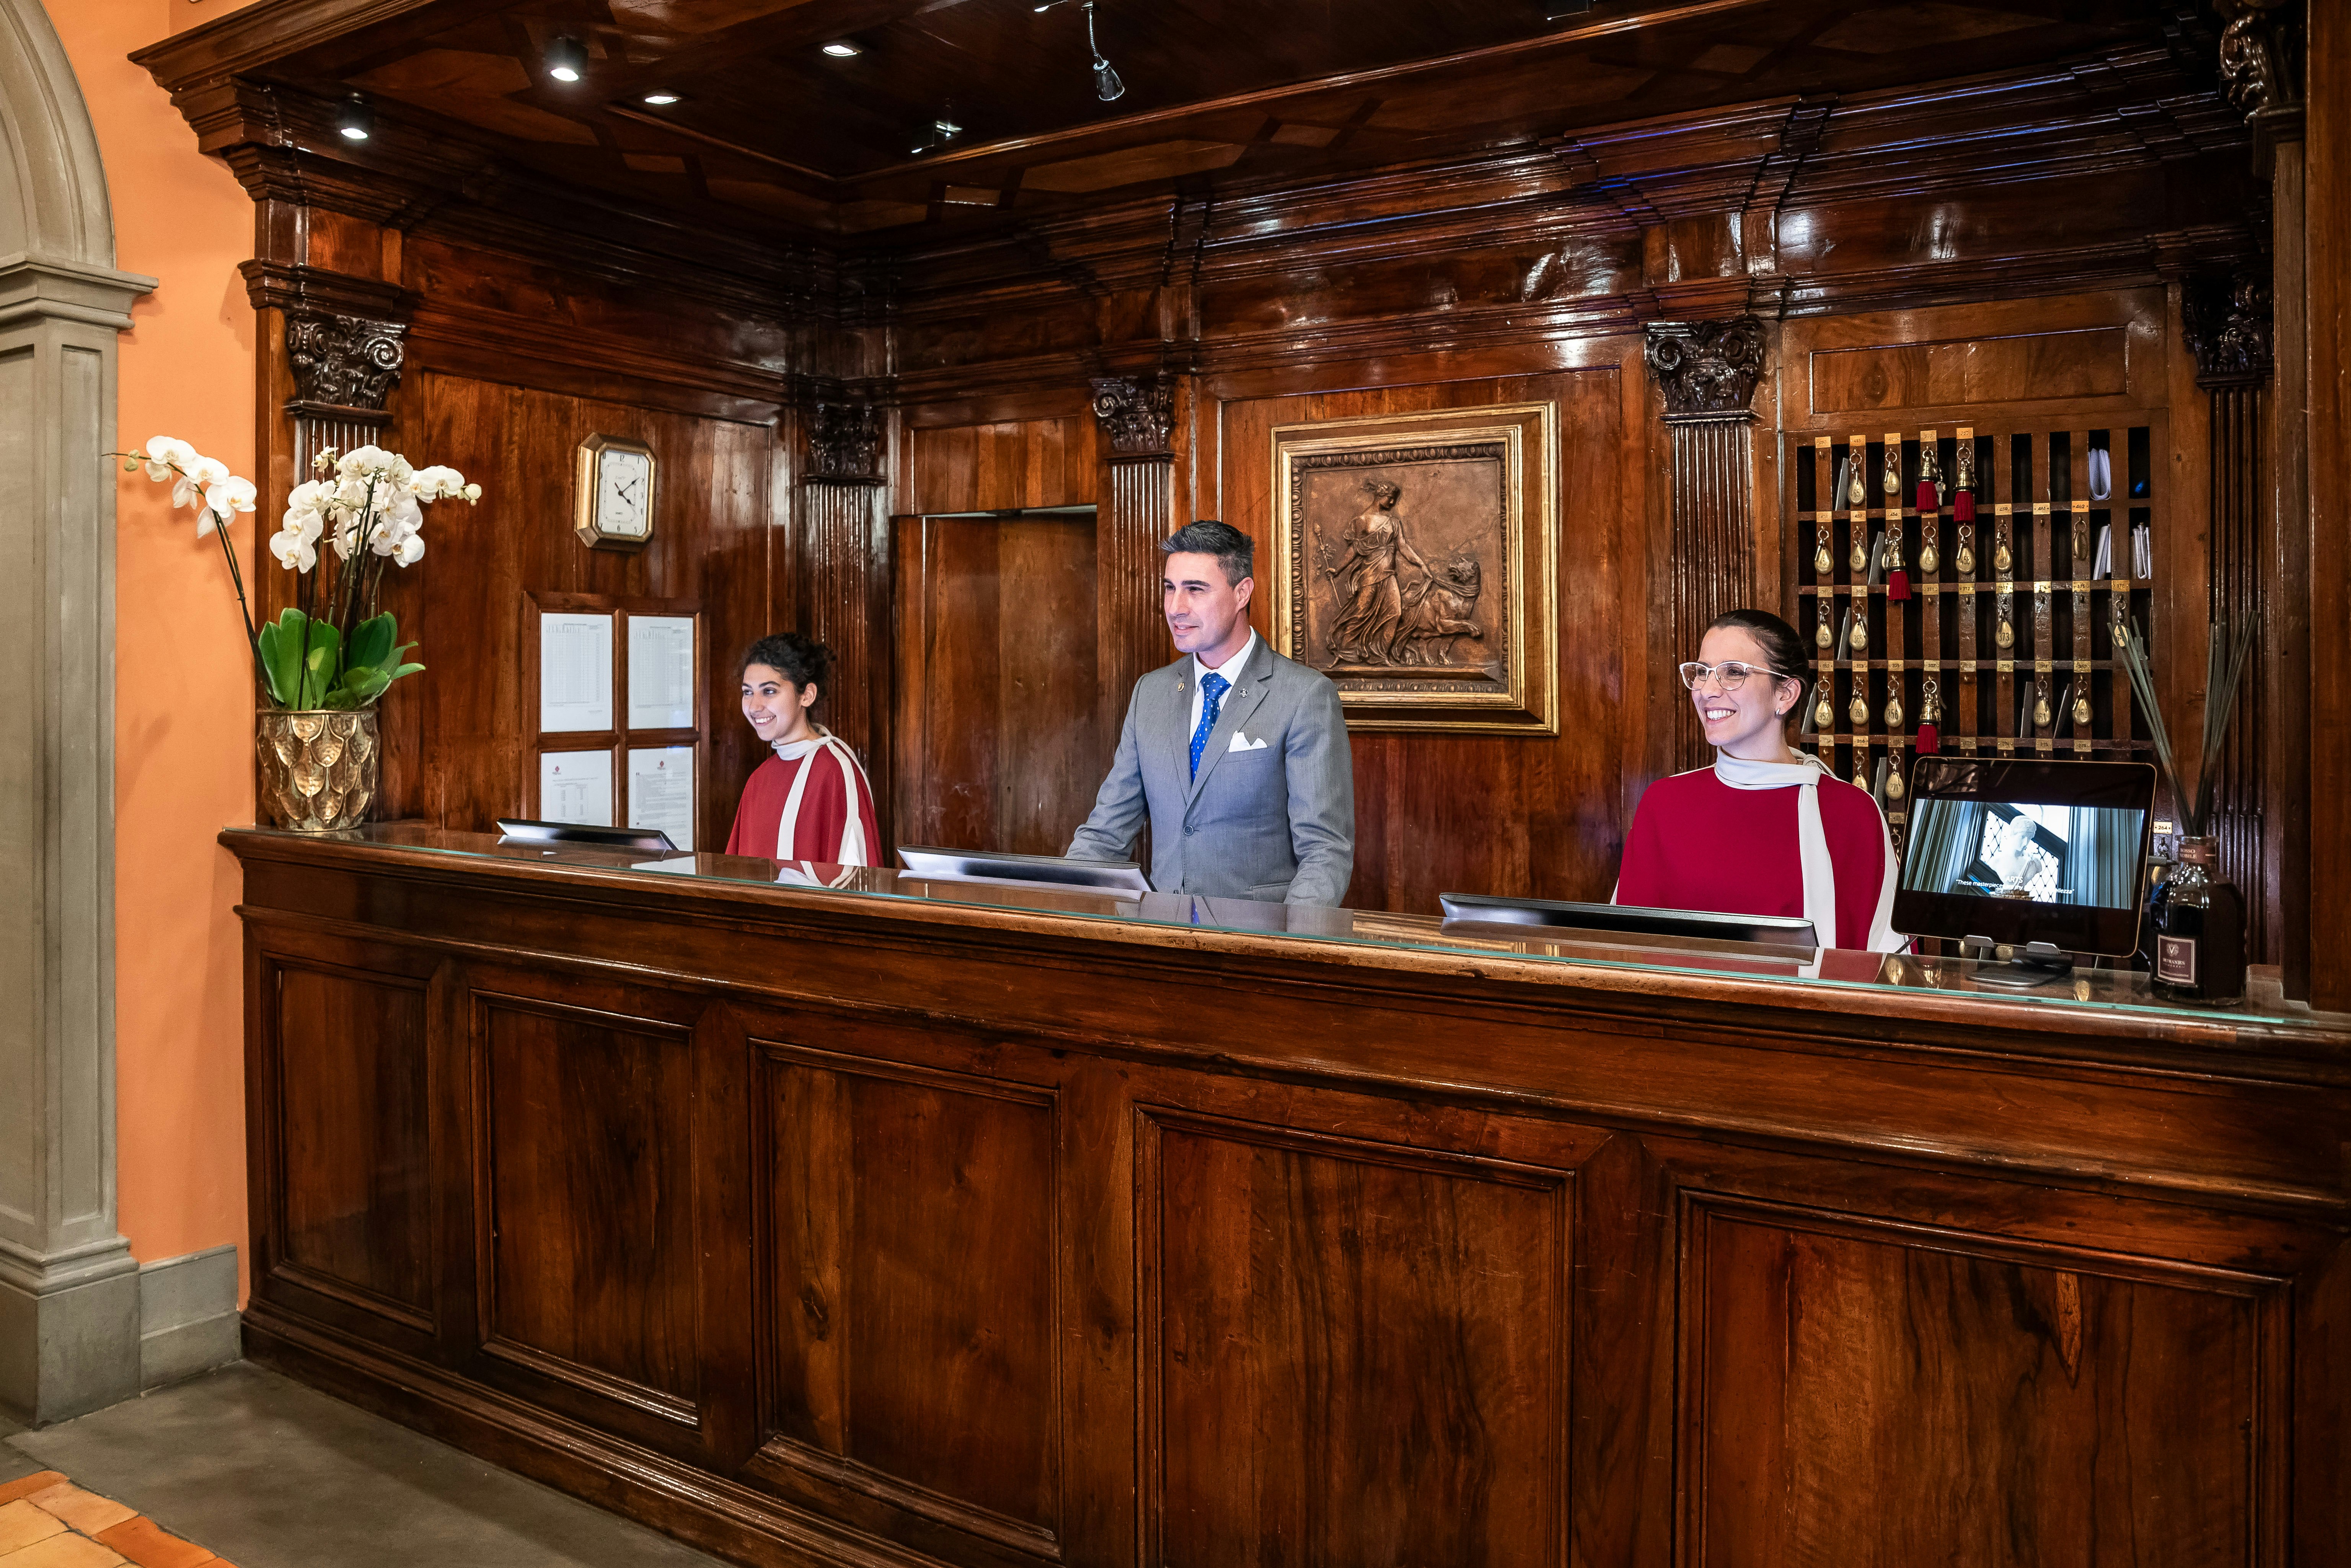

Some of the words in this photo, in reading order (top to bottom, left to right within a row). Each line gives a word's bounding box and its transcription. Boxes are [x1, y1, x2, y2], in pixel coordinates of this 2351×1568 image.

[1999, 632, 2009, 641] 373
[1819, 712, 1829, 721] 352
[2168, 945, 2175, 954] V
